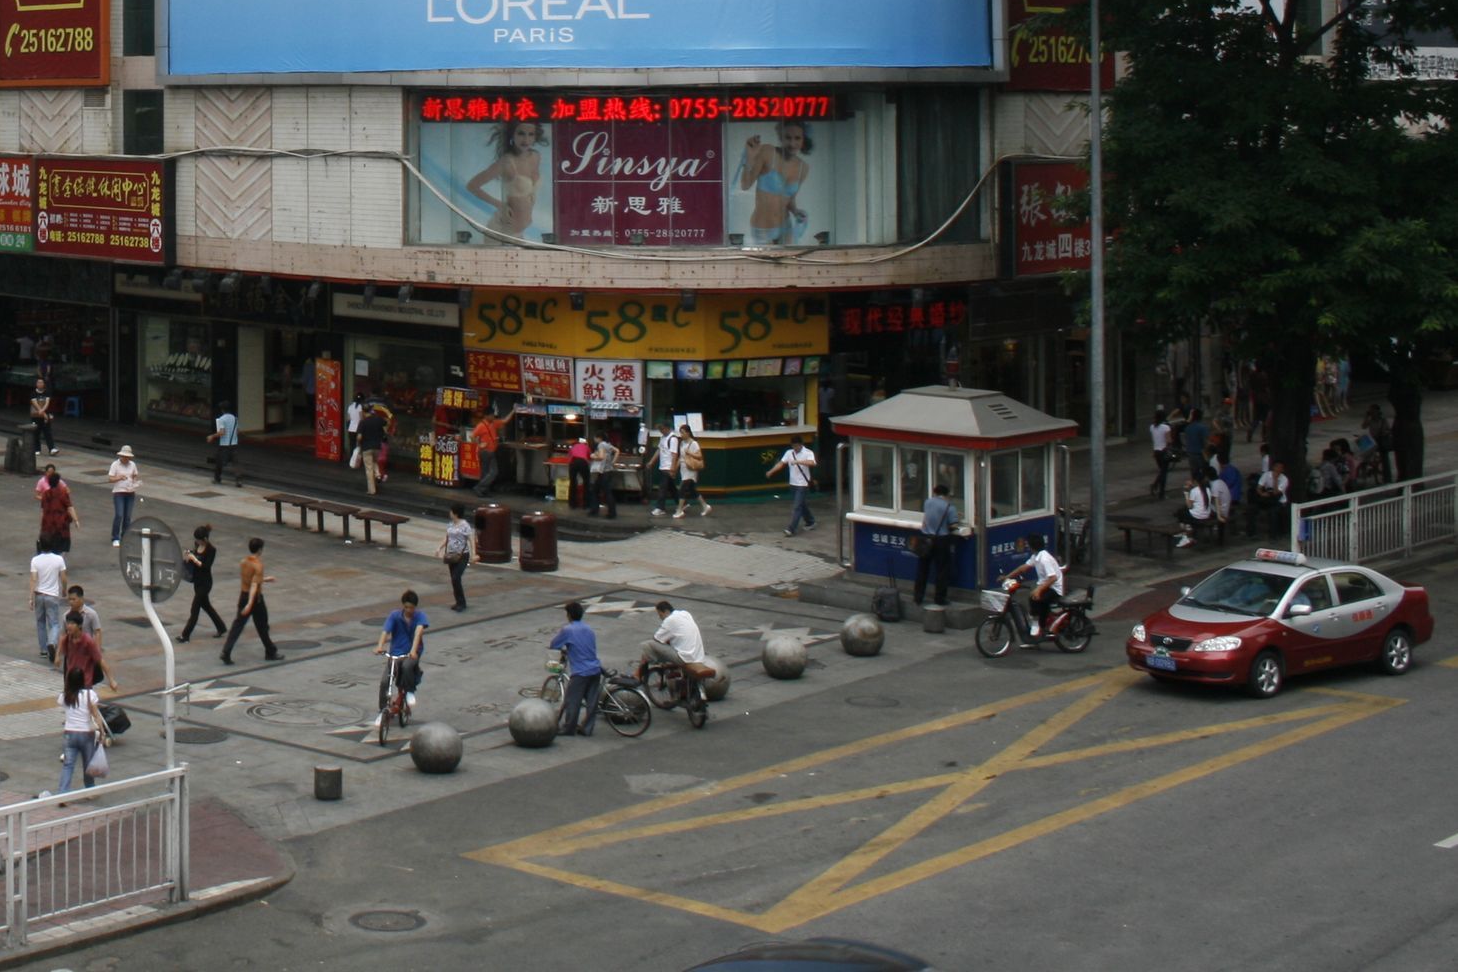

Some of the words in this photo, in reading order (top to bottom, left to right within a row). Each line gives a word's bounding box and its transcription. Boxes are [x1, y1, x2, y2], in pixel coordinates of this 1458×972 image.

[20, 28, 94, 54] 25162788
[421, 96, 539, 121] 新思雅内衣
[670, 97, 830, 120] 0755-28520777
[590, 195, 685, 215] 新思雅
